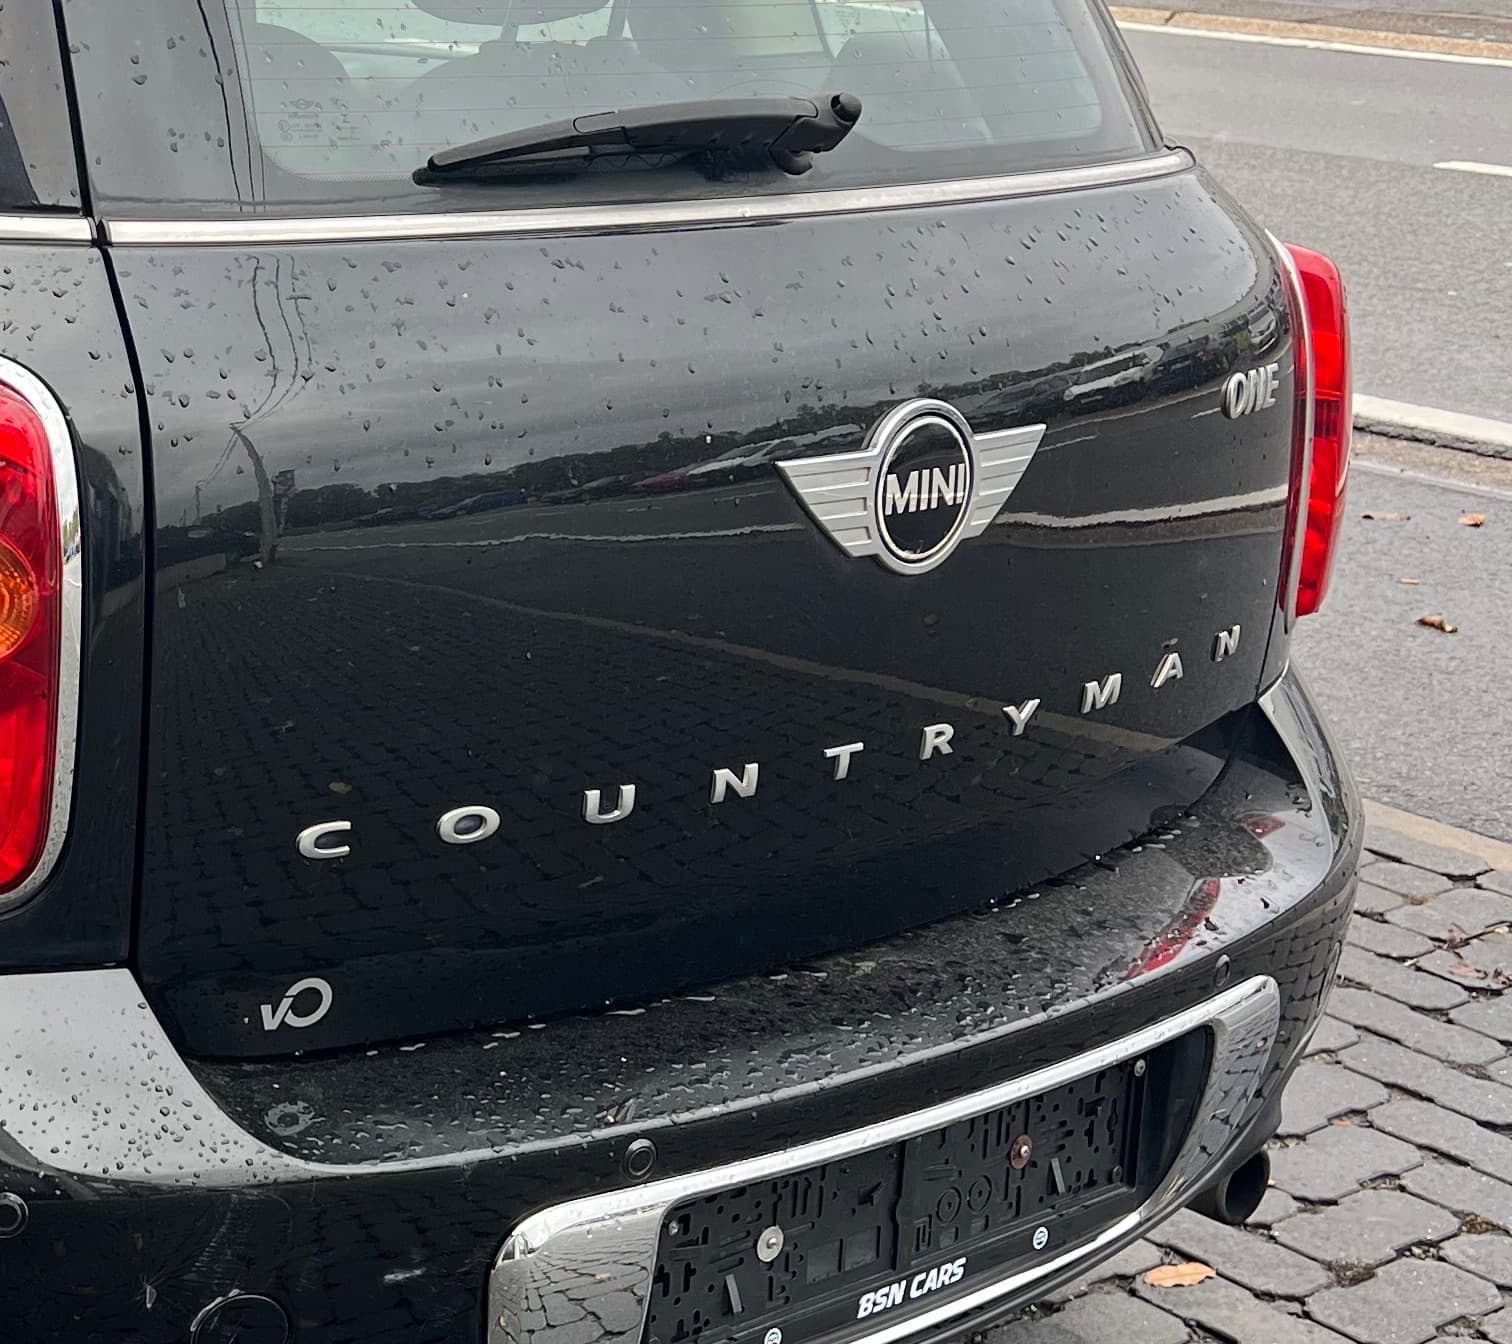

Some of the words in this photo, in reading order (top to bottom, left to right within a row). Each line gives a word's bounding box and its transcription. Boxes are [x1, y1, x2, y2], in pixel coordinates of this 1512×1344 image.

[1224, 362, 1280, 420] ONE
[885, 462, 965, 516] MINI
[296, 623, 1241, 860] COUNTRYMAN
[856, 1279, 907, 1319] BSN
[909, 1256, 967, 1299] CARS
